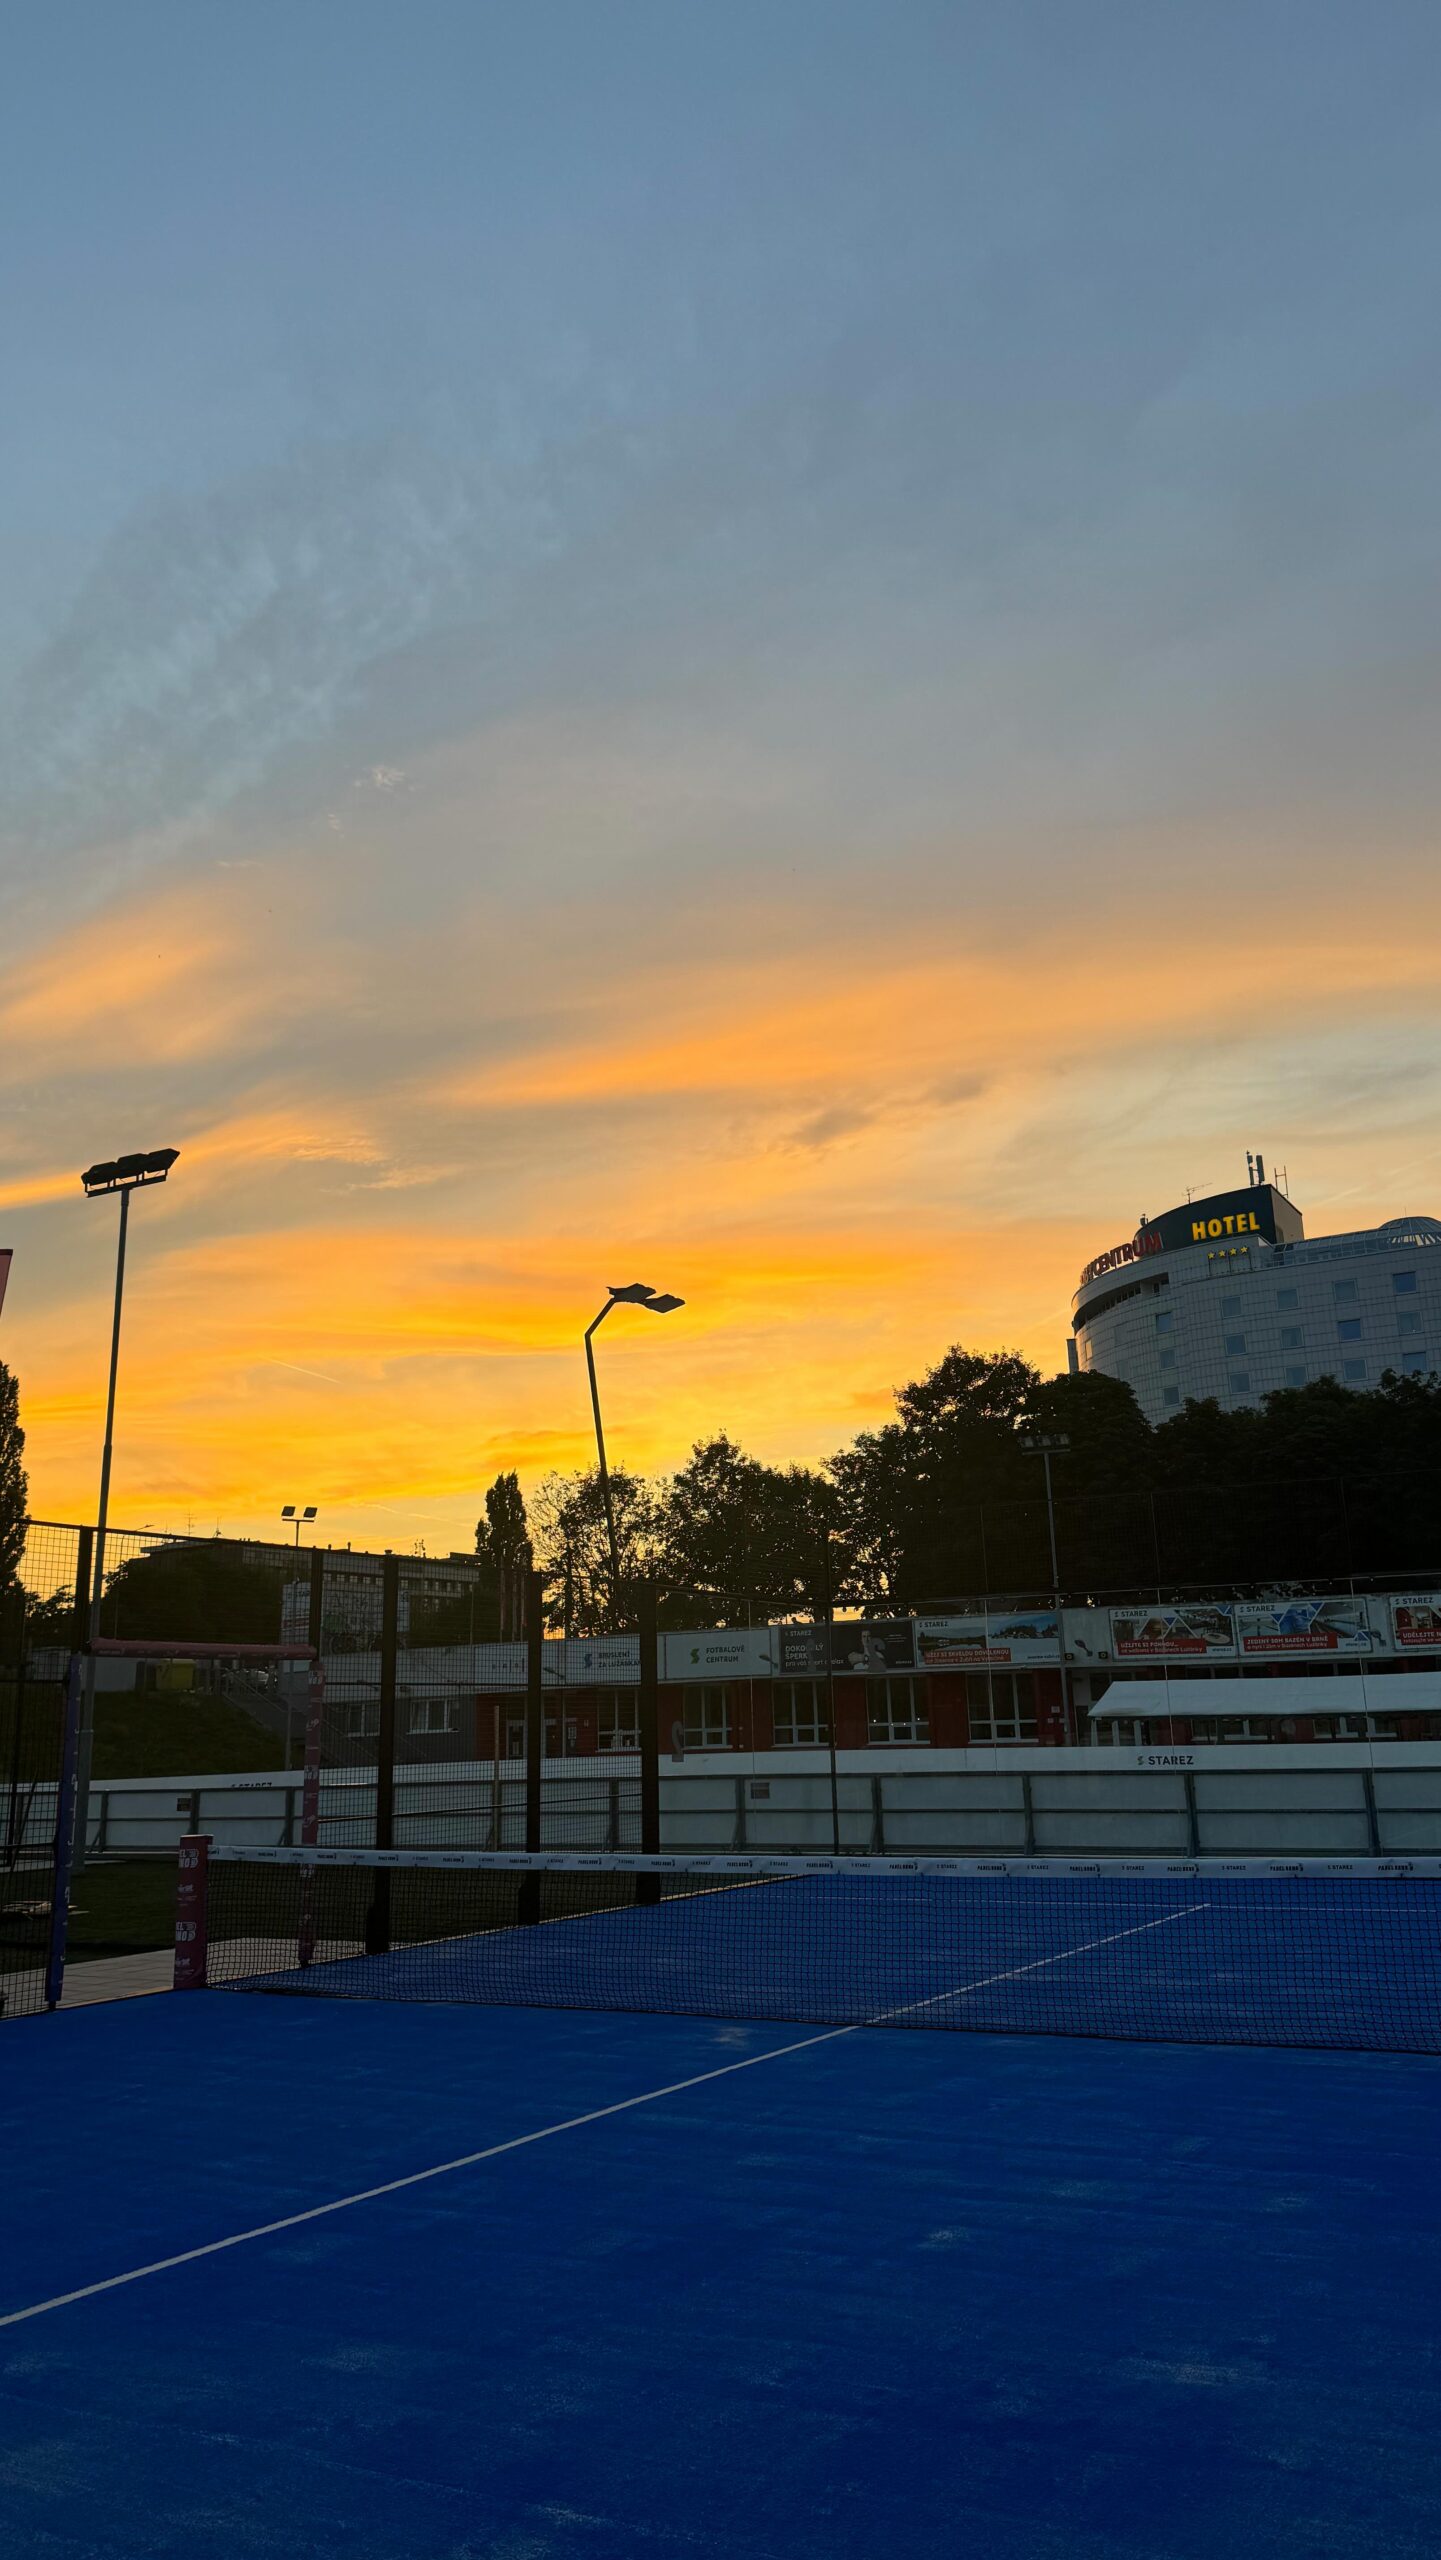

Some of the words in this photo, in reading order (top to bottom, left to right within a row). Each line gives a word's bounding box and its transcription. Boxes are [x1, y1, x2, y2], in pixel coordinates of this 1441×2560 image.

[1192, 1211, 1260, 1241] HOTEL
[1402, 1597, 1434, 1605] STAREZ
[1120, 1610, 1148, 1618] STAREZ
[790, 1629, 812, 1637] STAREZ
[706, 1645, 745, 1654] FOTBALOVÉ
[785, 1642, 824, 1652] DOKOLÝ
[706, 1655, 739, 1664] CENTRUM
[1148, 1755, 1194, 1765] STAREZ
